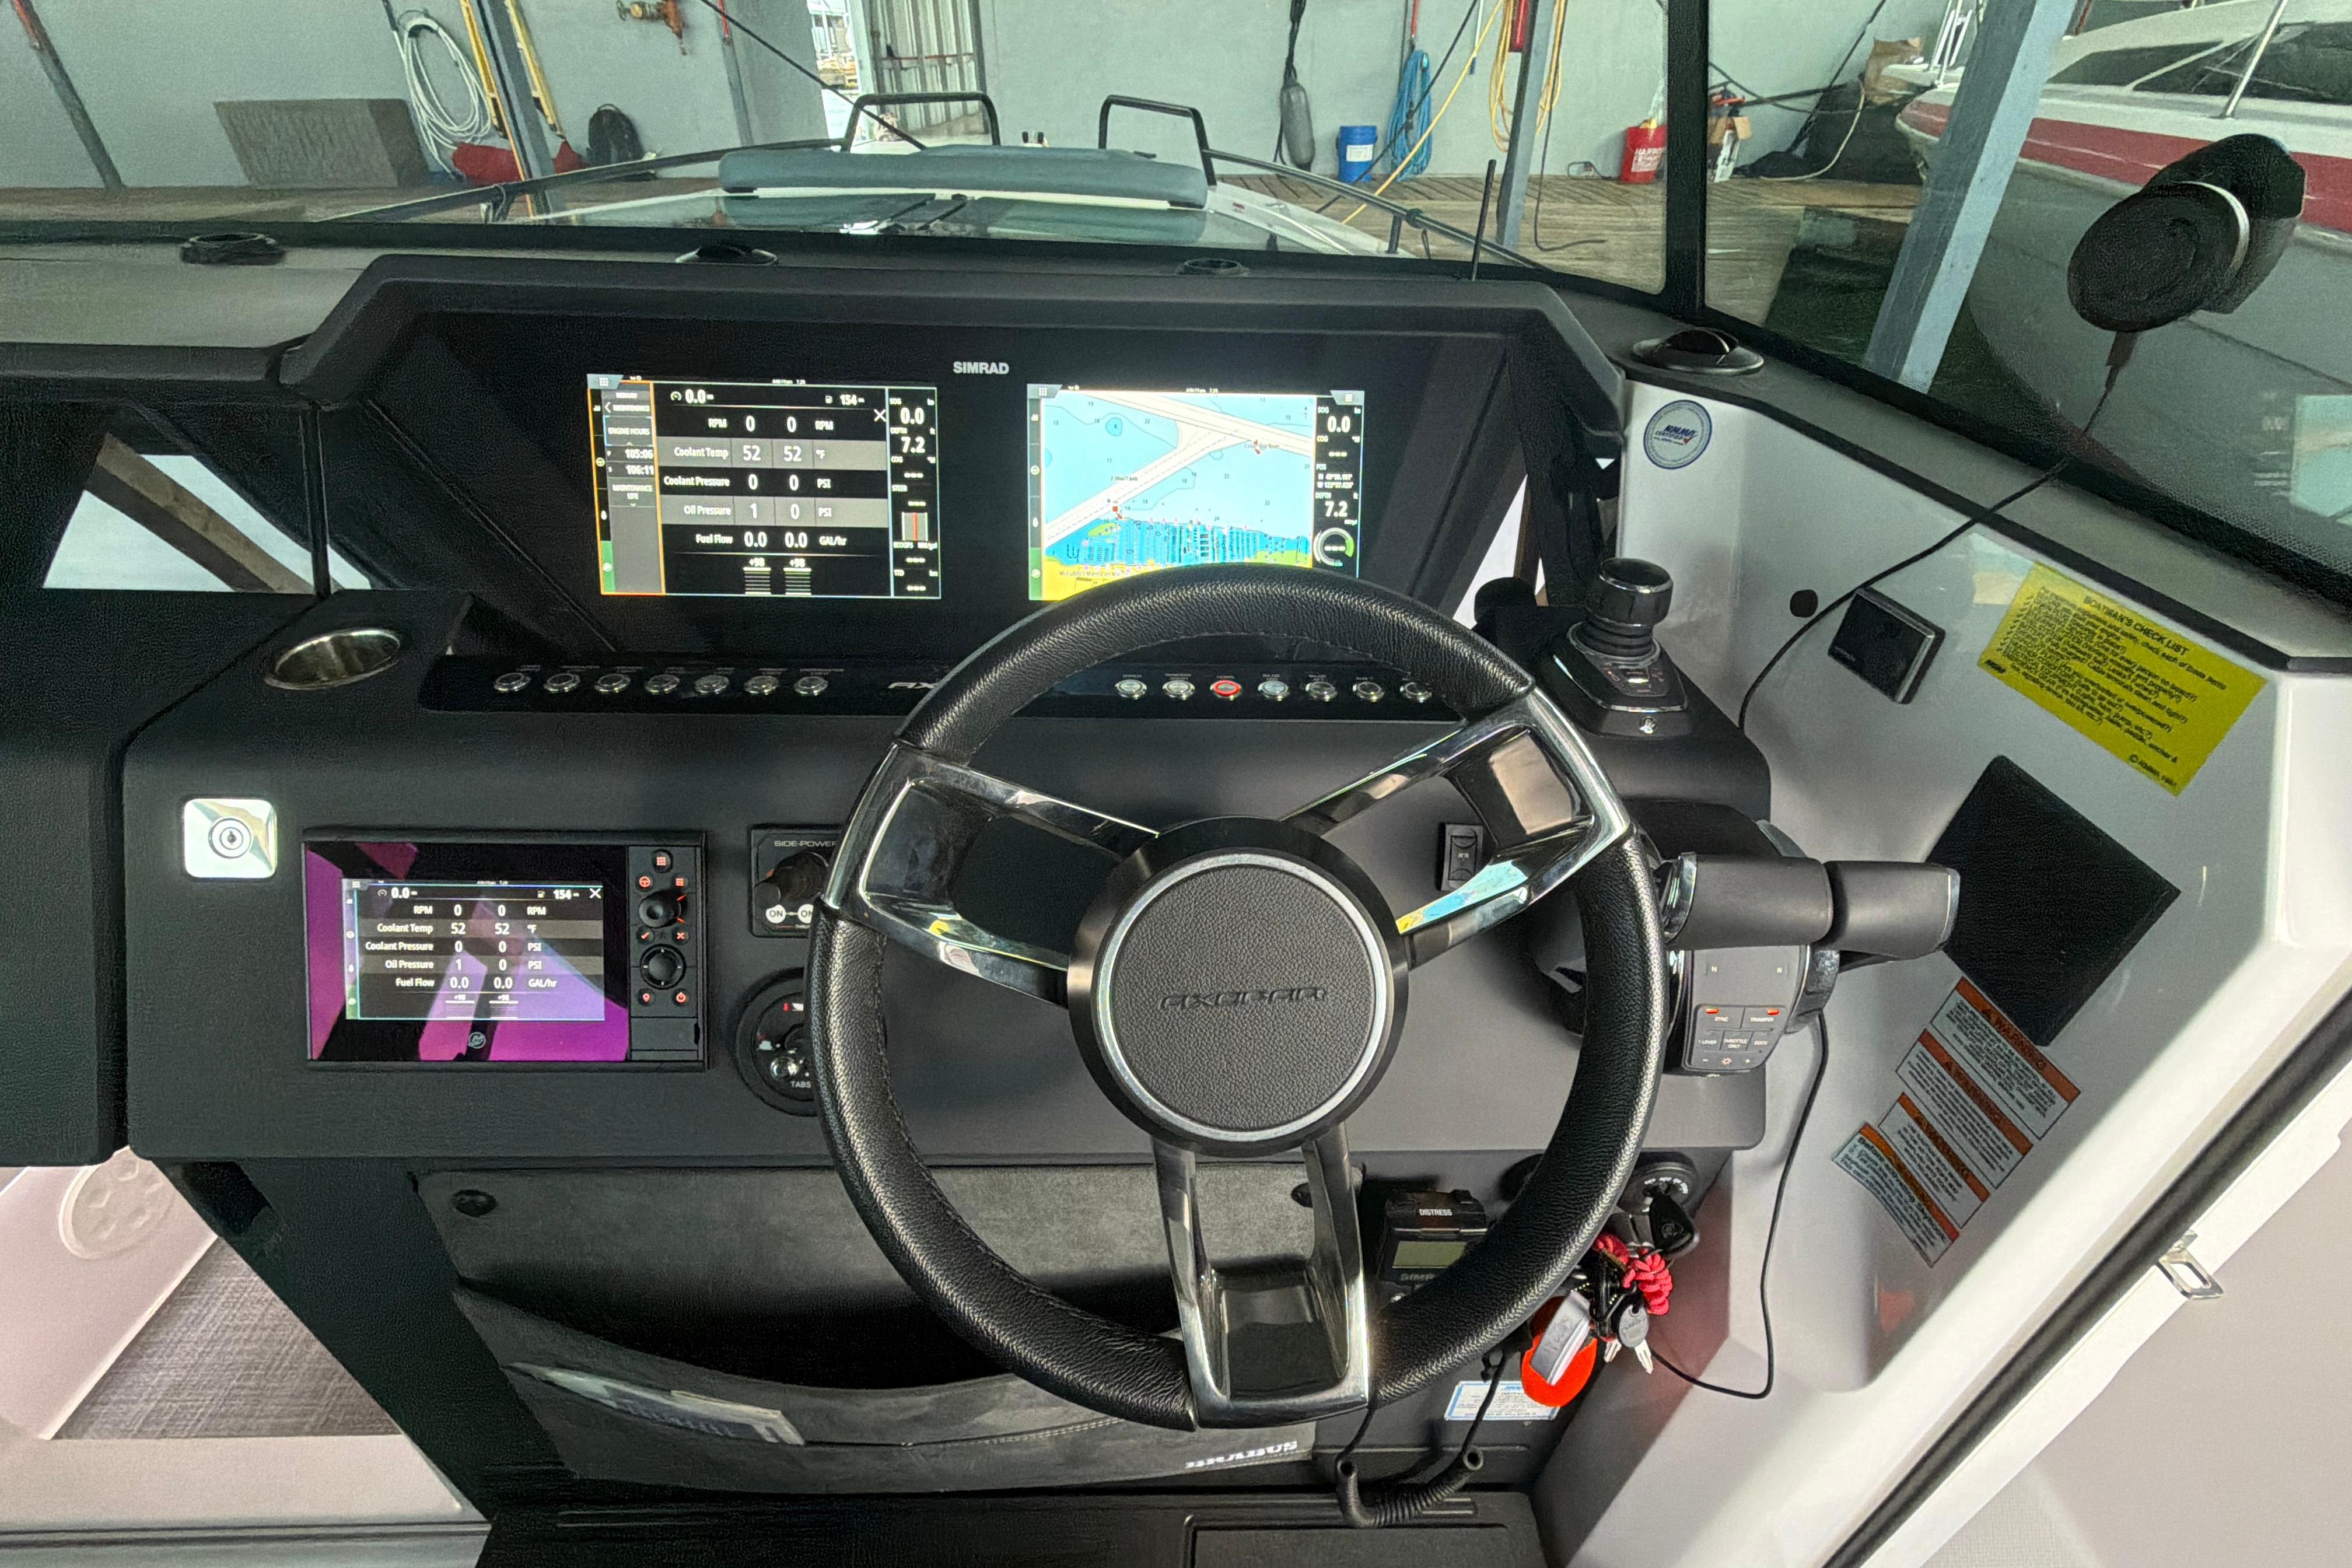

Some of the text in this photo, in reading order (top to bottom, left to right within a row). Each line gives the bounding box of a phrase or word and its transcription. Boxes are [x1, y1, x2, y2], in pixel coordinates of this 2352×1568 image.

[953, 361, 1010, 374] SIMRAD
[685, 389, 706, 404] 0.0
[840, 394, 858, 406] 154
[889, 397, 902, 405] SOG
[900, 407, 925, 425] 0.0
[708, 415, 834, 433] RPM 0 0 RPM
[890, 426, 908, 435] DEPTH
[1327, 416, 1350, 433] 0.0
[608, 427, 630, 435] ENGINE
[901, 436, 926, 454] 7.2
[625, 449, 654, 459] 105:06
[674, 447, 705, 457] Coolant
[705, 447, 729, 460] Temp
[743, 444, 762, 461] 52
[783, 445, 803, 463] 52
[625, 464, 654, 475] 106:11
[663, 474, 832, 491] Coolant Pressure 0 0 PSI
[683, 503, 832, 520] Oil Pressure 1 0 PSI
[1325, 501, 1348, 517] 7.2
[695, 531, 848, 548] Fuel Flow 0.0 0.0 GAL/hr
[2082, 595, 2134, 628] BOATMAN'S
[2132, 621, 2167, 645] CHECK
[2164, 638, 2189, 656] LIST
[391, 887, 410, 899] 0.0
[553, 889, 572, 900] 154
[414, 904, 546, 916] RPM 0 0 RPM
[377, 923, 410, 933] Coolant
[410, 923, 433, 935] Temp
[450, 922, 466, 935] 52
[495, 923, 510, 935] 52
[365, 940, 542, 953] Coolant Pressure 0 0 PSI
[385, 958, 542, 971] Oil Pressure 1 0 PSI
[396, 977, 557, 989] Fuel Flow 0.0 0.0 GAL/hr
[790, 1080, 811, 1088] TABS
[1419, 1208, 1452, 1216] DISTRESS
[1185, 1440, 1298, 1469] BRABUS
